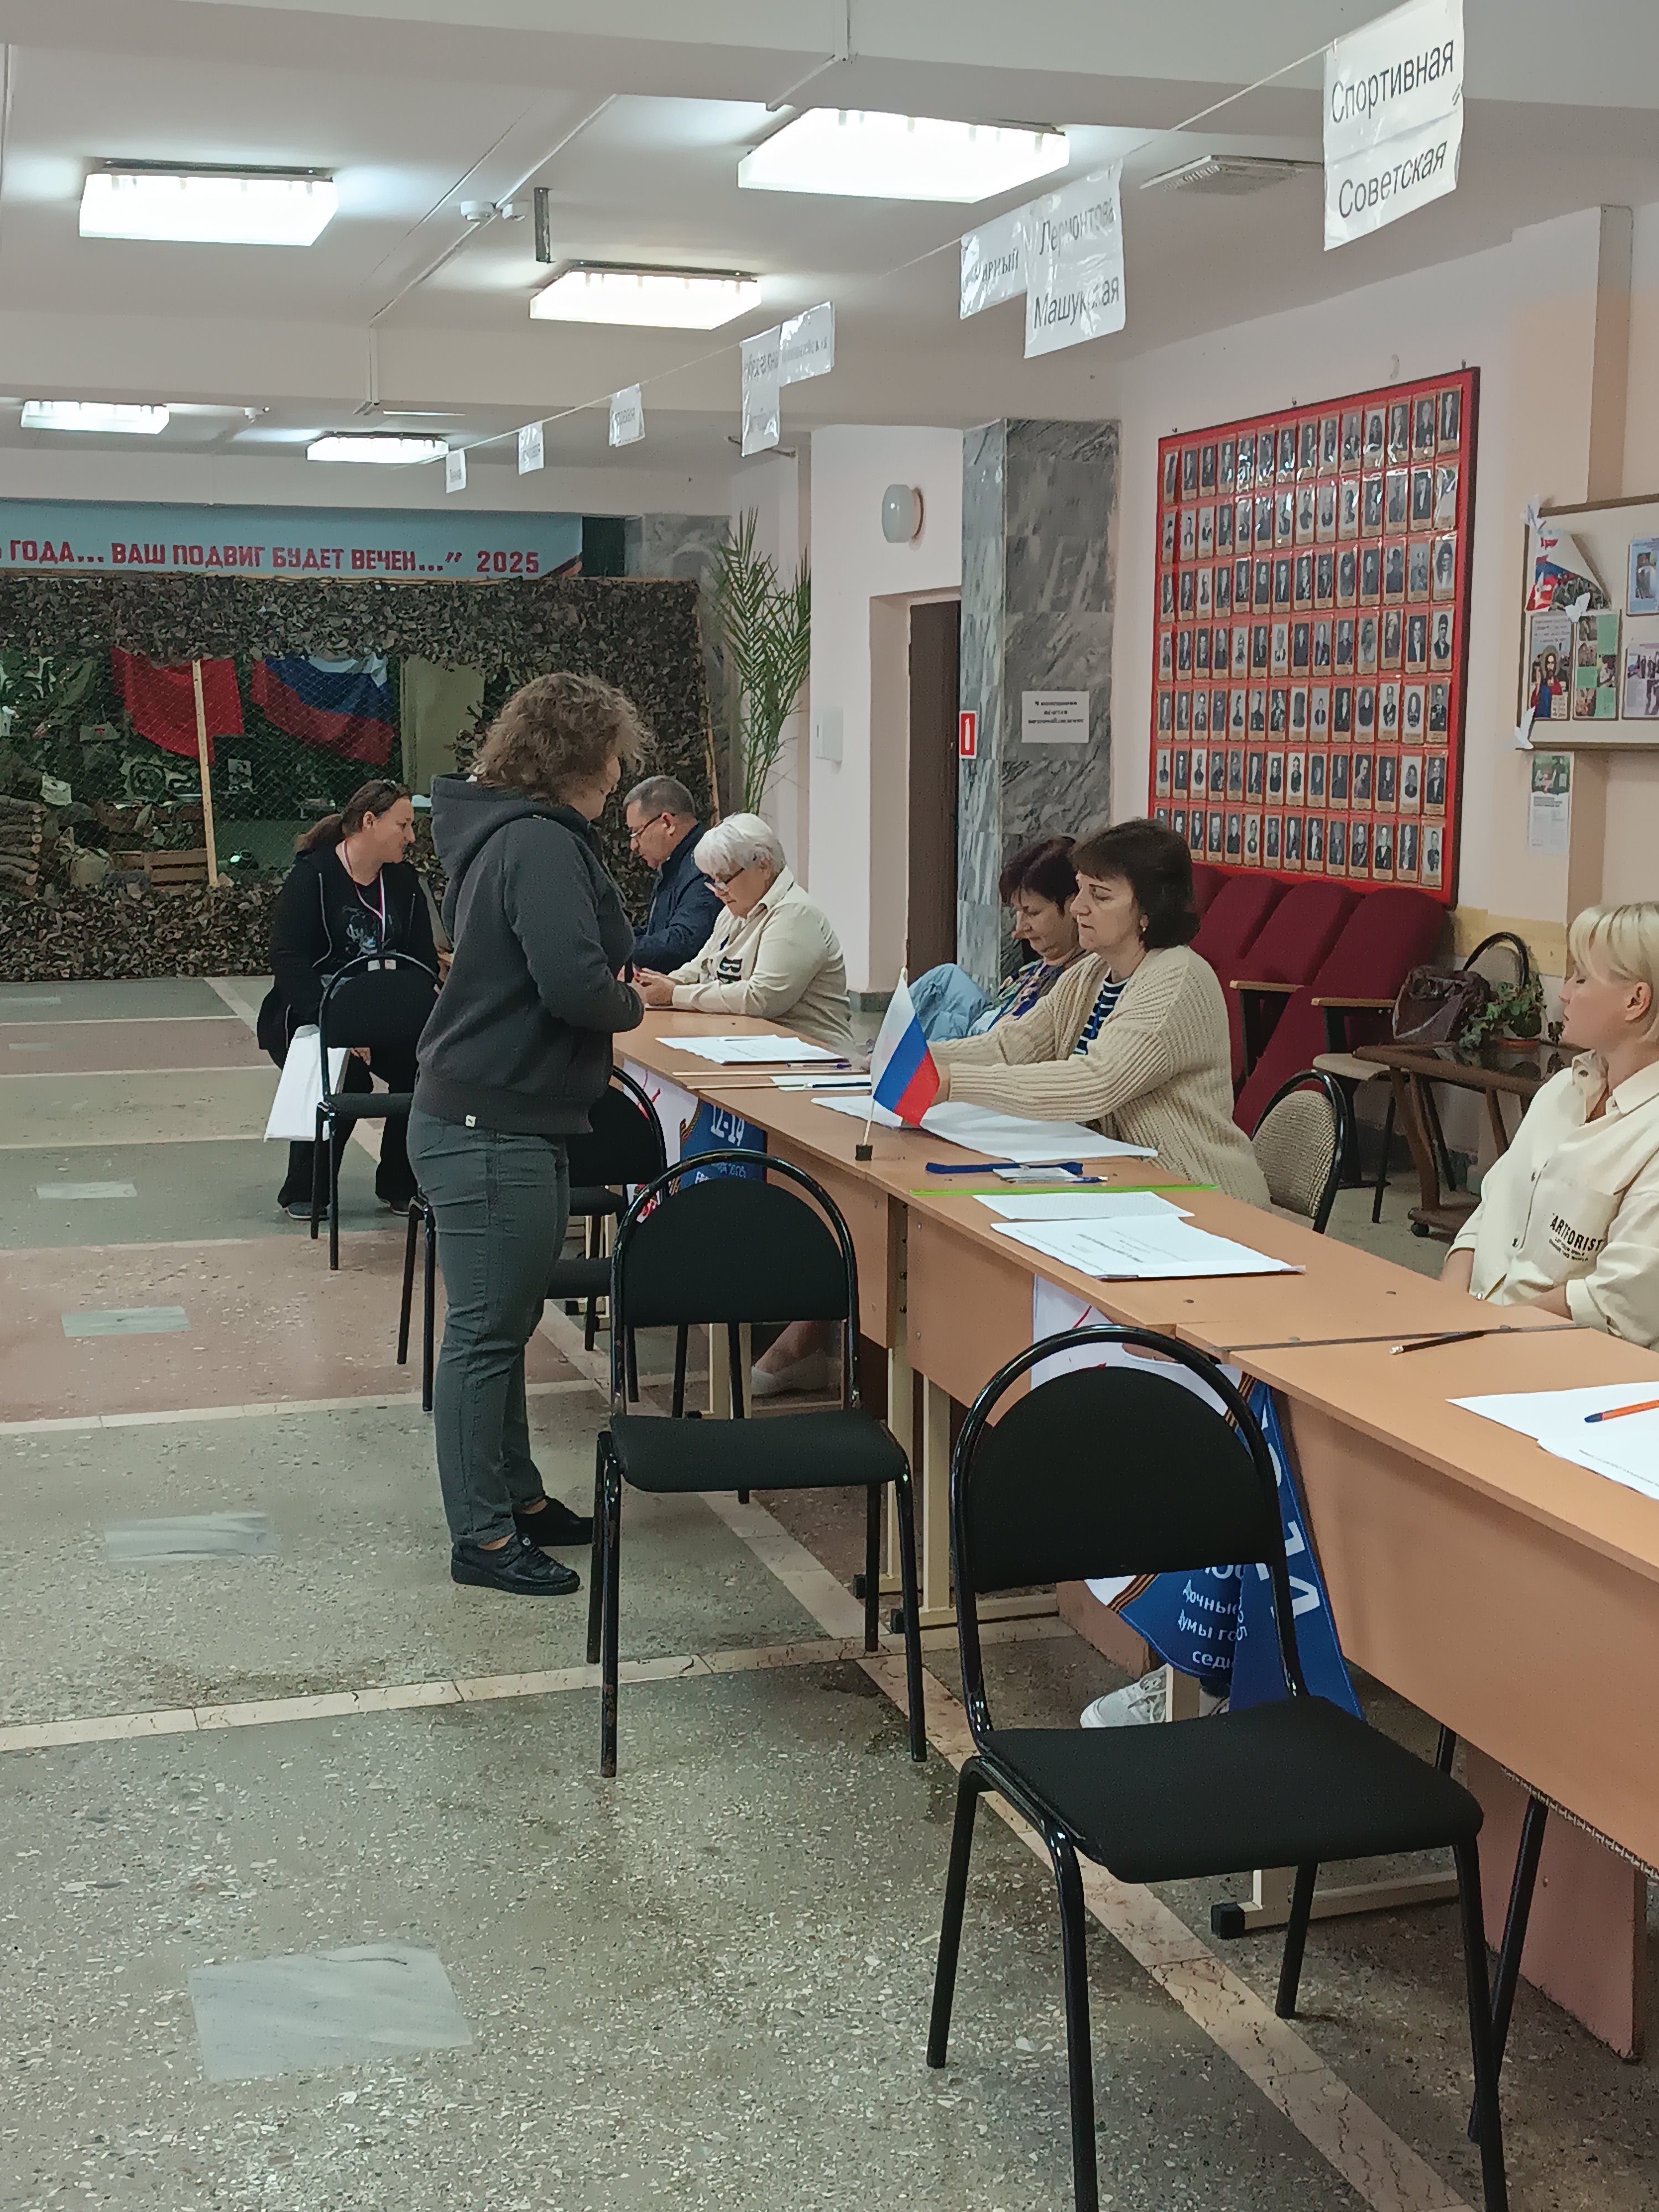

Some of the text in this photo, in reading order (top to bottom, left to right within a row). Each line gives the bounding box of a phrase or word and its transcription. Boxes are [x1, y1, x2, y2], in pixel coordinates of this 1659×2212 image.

[1332, 39, 1454, 123] Спортивная
[1338, 140, 1448, 218] Советская
[9, 540, 104, 565] ГОДА...
[111, 542, 166, 565] ВАШ
[173, 545, 265, 568] ПОДВИГ
[273, 546, 344, 571] БУДЕТ
[477, 550, 539, 573] 2025
